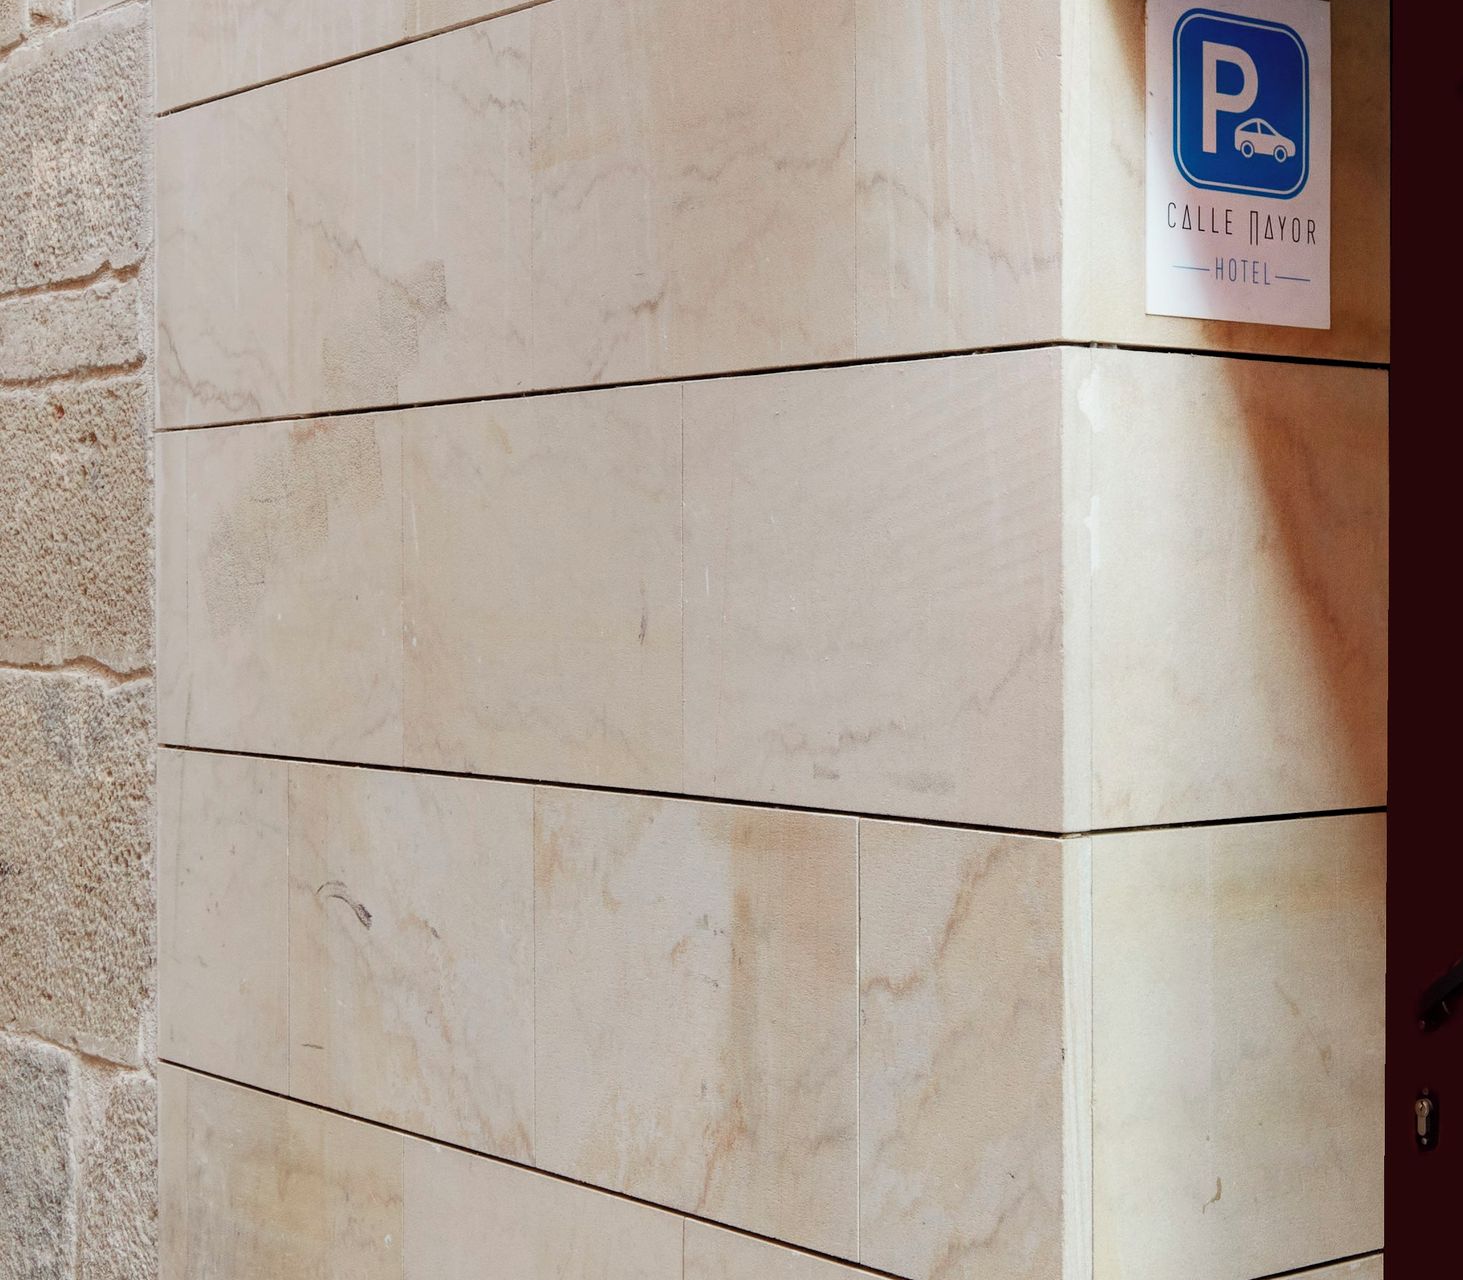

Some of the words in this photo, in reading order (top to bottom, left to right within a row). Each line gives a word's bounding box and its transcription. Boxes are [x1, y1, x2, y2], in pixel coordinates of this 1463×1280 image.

[1202, 40, 1259, 154] P
[1167, 202, 1233, 235] CALLE
[1215, 257, 1271, 285] HOTEL
